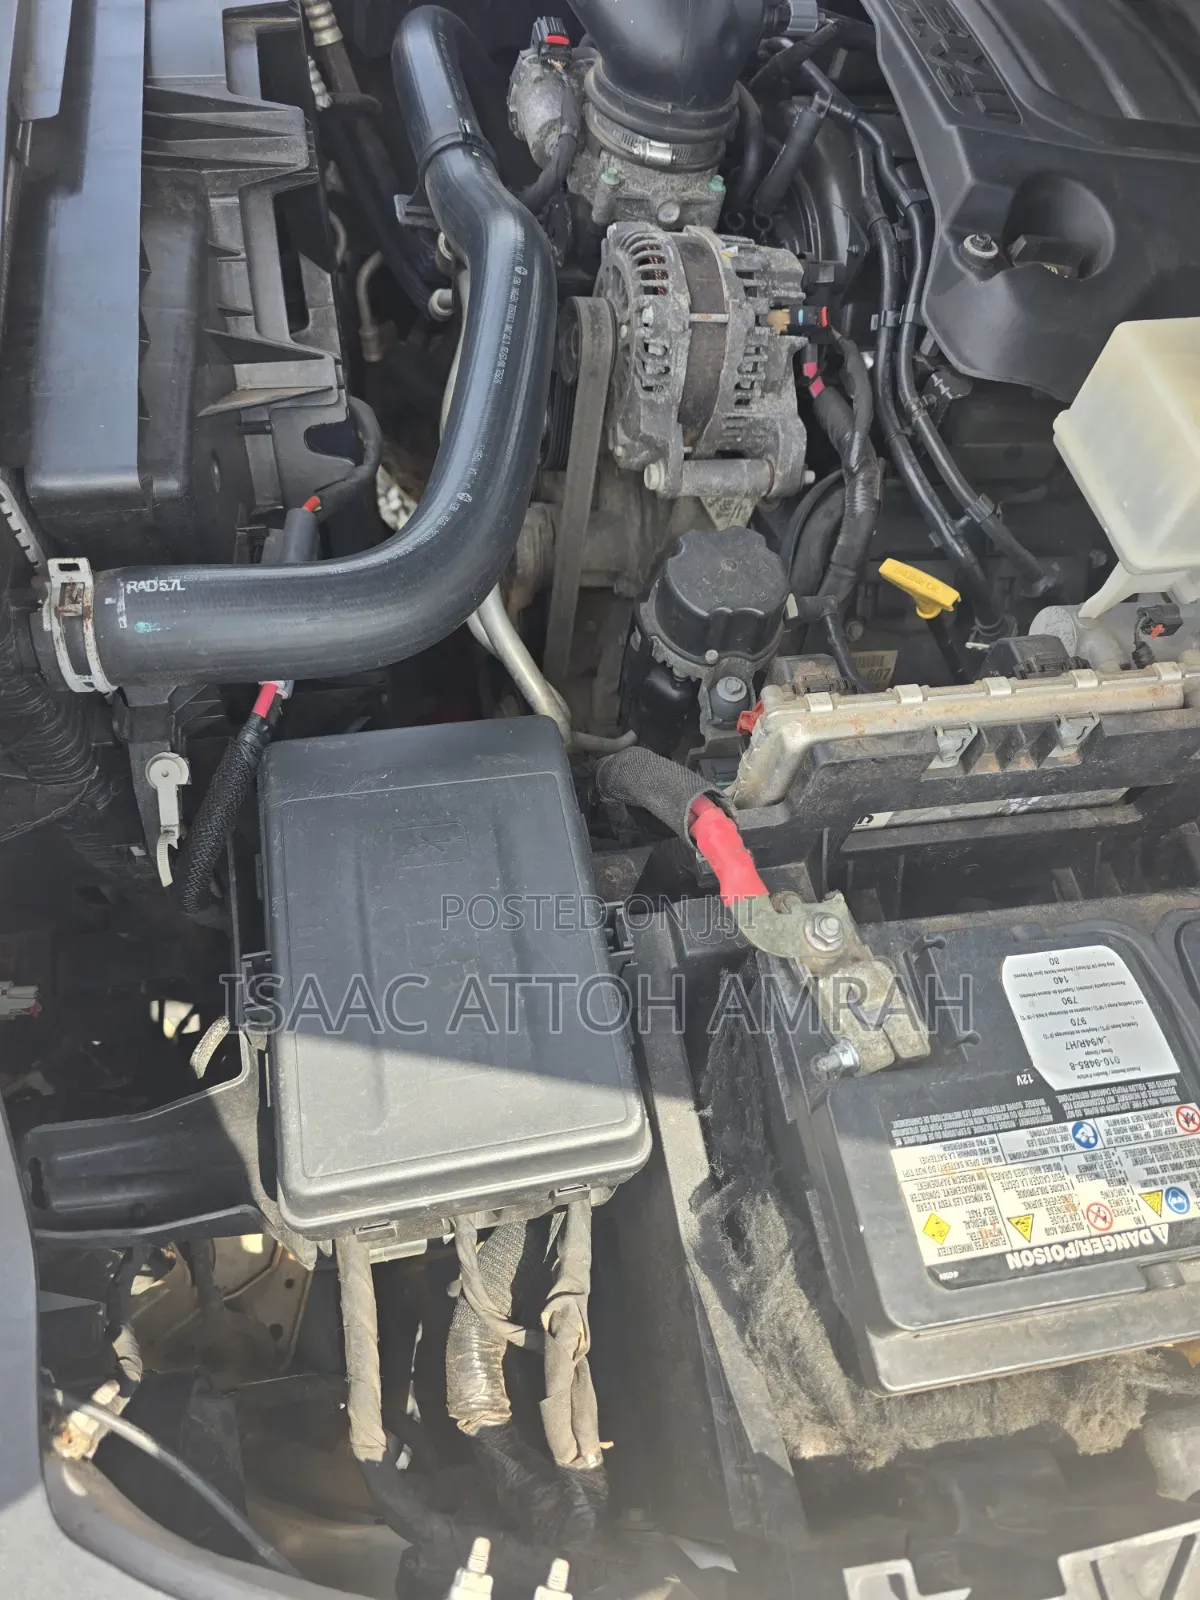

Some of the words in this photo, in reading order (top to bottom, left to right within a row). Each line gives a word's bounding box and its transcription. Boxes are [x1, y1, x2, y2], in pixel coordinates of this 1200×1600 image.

[1048, 956, 1059, 965] 80
[1052, 975, 1069, 984] 140
[1060, 995, 1078, 1005] 790
[1069, 1016, 1086, 1026] 970
[1068, 1055, 1120, 1071] 010-9485-8
[1014, 1073, 1034, 1085] 12V
[1025, 1138, 1037, 1147] LES
[1060, 1143, 1076, 1152] READ
[1048, 1145, 1060, 1154] ALL
[964, 1158, 980, 1167] OPEN
[980, 1156, 992, 1164] NOT
[914, 1166, 927, 1175] NOT
[1019, 1178, 1028, 1187] LA
[1099, 1187, 1126, 1199] SMOKING
[951, 1196, 963, 1206] LES
[1107, 1196, 1130, 1207] FLAMES
[1111, 1205, 1134, 1217] SPARKS
[962, 1217, 988, 1229] MEDICAL
[1049, 1214, 1069, 1225] CAUSE
[1132, 1216, 1142, 1224] NO
[935, 1242, 974, 1257] IMMEDIATELY
[1004, 1227, 1155, 1269] DANGER/POISON
